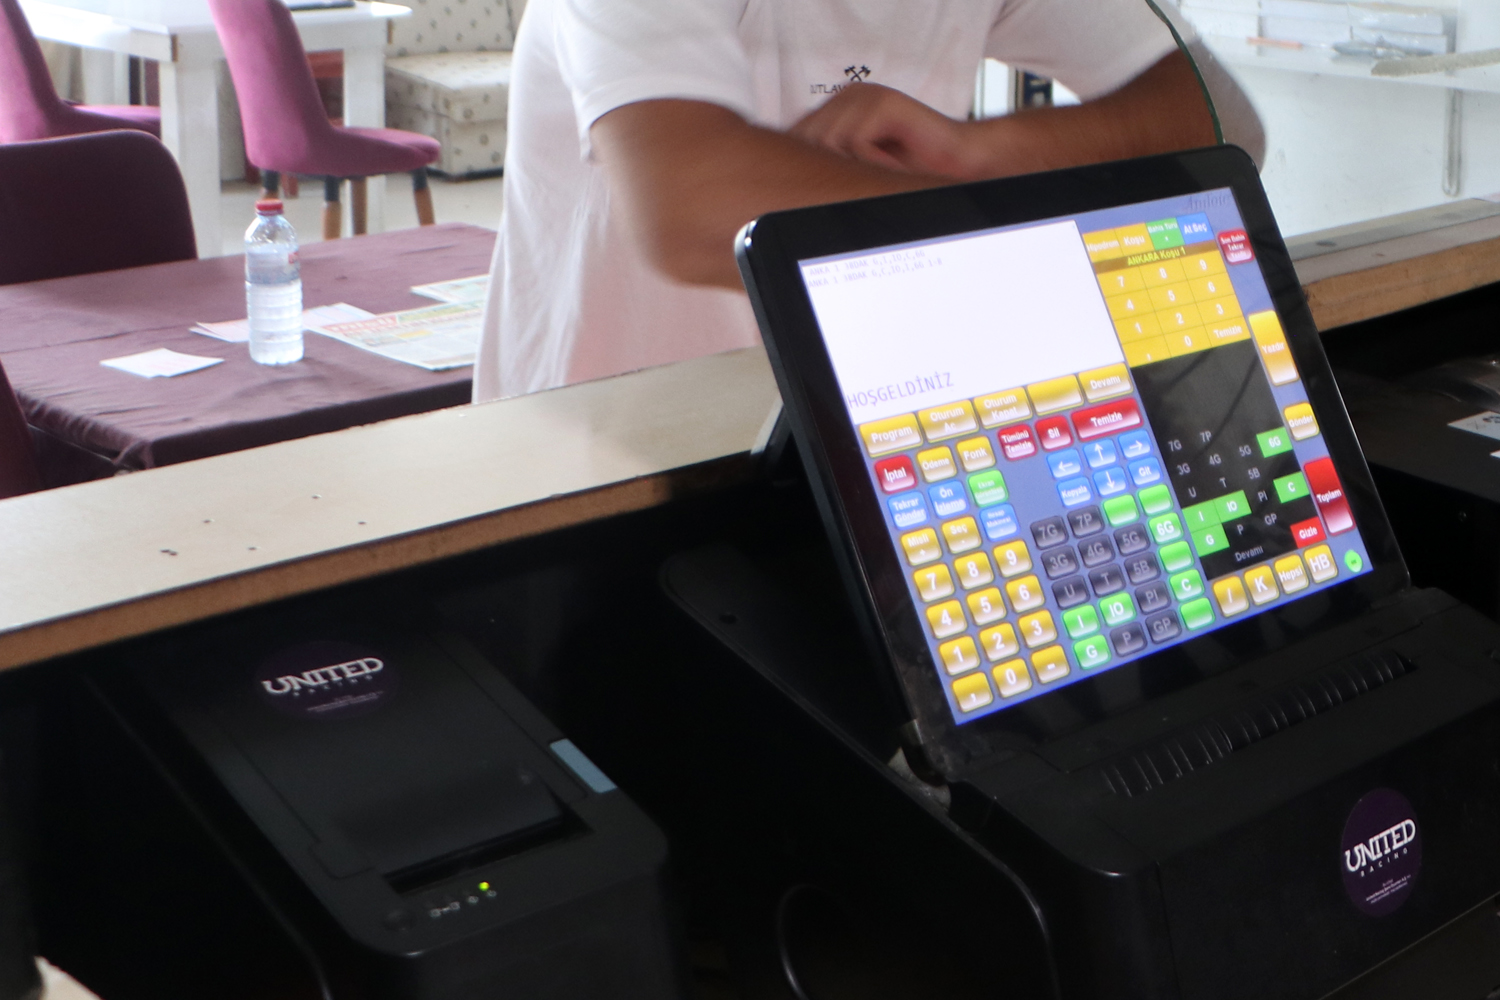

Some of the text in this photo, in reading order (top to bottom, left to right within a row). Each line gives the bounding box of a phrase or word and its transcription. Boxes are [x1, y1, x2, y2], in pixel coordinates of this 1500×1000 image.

[1123, 236, 1145, 247] Koşu
[1127, 249, 1180, 267] ANKARA Koşu
[810, 266, 831, 276] ANKA
[808, 278, 829, 288] ANKA
[1213, 325, 1243, 338] Temizle
[847, 371, 954, 408] HOŞGELDİNİZ
[1090, 374, 1121, 390] Devamı
[983, 394, 1018, 409] Oturum
[929, 406, 965, 422] Oturum
[991, 407, 1019, 420] Kapat
[1090, 411, 1123, 427] Temizle
[1288, 414, 1313, 428] Gönder
[871, 426, 913, 444] Program
[1001, 429, 1029, 443] Tümünü
[1047, 427, 1060, 439] Sil
[1200, 430, 1212, 443] 7P
[1005, 440, 1033, 454] Temizle
[1168, 438, 1182, 452] 7G
[1268, 435, 1282, 448] 6G
[963, 446, 988, 461] Fonk
[1239, 444, 1251, 457] 5G
[922, 457, 950, 471] Ödeme
[1208, 453, 1222, 466] 4G
[883, 466, 907, 483] İptal
[1138, 465, 1152, 477] Git
[1177, 463, 1191, 475] 3G
[1248, 467, 1261, 480] 5B
[940, 486, 954, 498] Ön
[1061, 485, 1088, 499] Kopyala
[1317, 487, 1342, 504] Toplam
[892, 497, 919, 511] Tekrar
[934, 498, 966, 512] İzleme
[894, 508, 925, 522] Gönder
[1076, 513, 1093, 528] 7P
[1264, 513, 1277, 526] GP
[950, 521, 968, 534] Seç
[1038, 523, 1058, 538] 7G
[1156, 520, 1175, 537] 6G
[1298, 525, 1319, 540] Gizle
[907, 533, 930, 547] Misli
[1122, 531, 1141, 546] 5G
[1087, 542, 1105, 558] 4G
[1235, 545, 1264, 562] Devamı
[1006, 549, 1018, 567] 9
[1050, 553, 1069, 568] 3G
[1309, 553, 1331, 573] HB
[967, 561, 979, 578] 8
[1132, 560, 1150, 575] 5B
[1278, 567, 1303, 582] Hepsi
[926, 572, 937, 591] 7
[1018, 584, 1030, 601] 6
[979, 596, 992, 614] 5
[941, 608, 952, 625] 4
[1031, 619, 1042, 637] 3
[1153, 618, 1171, 634] GP
[992, 632, 1005, 650] 2
[953, 645, 964, 663] 1
[261, 657, 384, 694] UNITED
[1005, 668, 1017, 685] 0
[1344, 818, 1416, 872] UNITED
[1360, 847, 1408, 878] RACING
